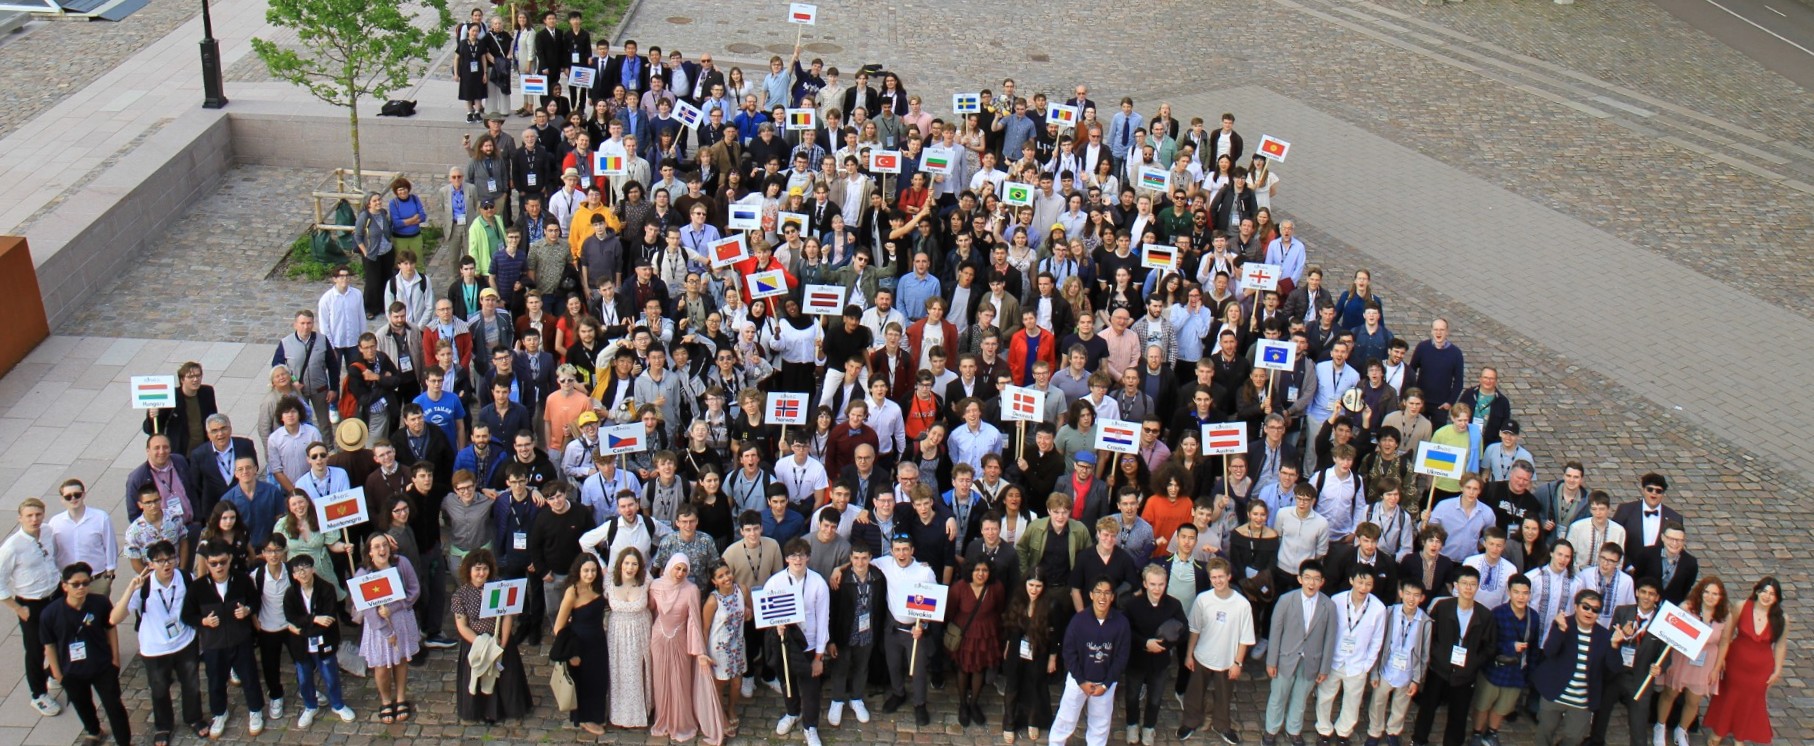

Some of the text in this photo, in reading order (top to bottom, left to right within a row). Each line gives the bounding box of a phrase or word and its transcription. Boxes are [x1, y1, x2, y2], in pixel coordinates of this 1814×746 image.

[1013, 412, 1033, 420] Denmark
[1427, 468, 1448, 477] Ukraine
[327, 516, 362, 529] Montenegro
[368, 597, 393, 607] Vietnam
[908, 609, 932, 618] Slovakia
[1659, 630, 1688, 652] Singapore
